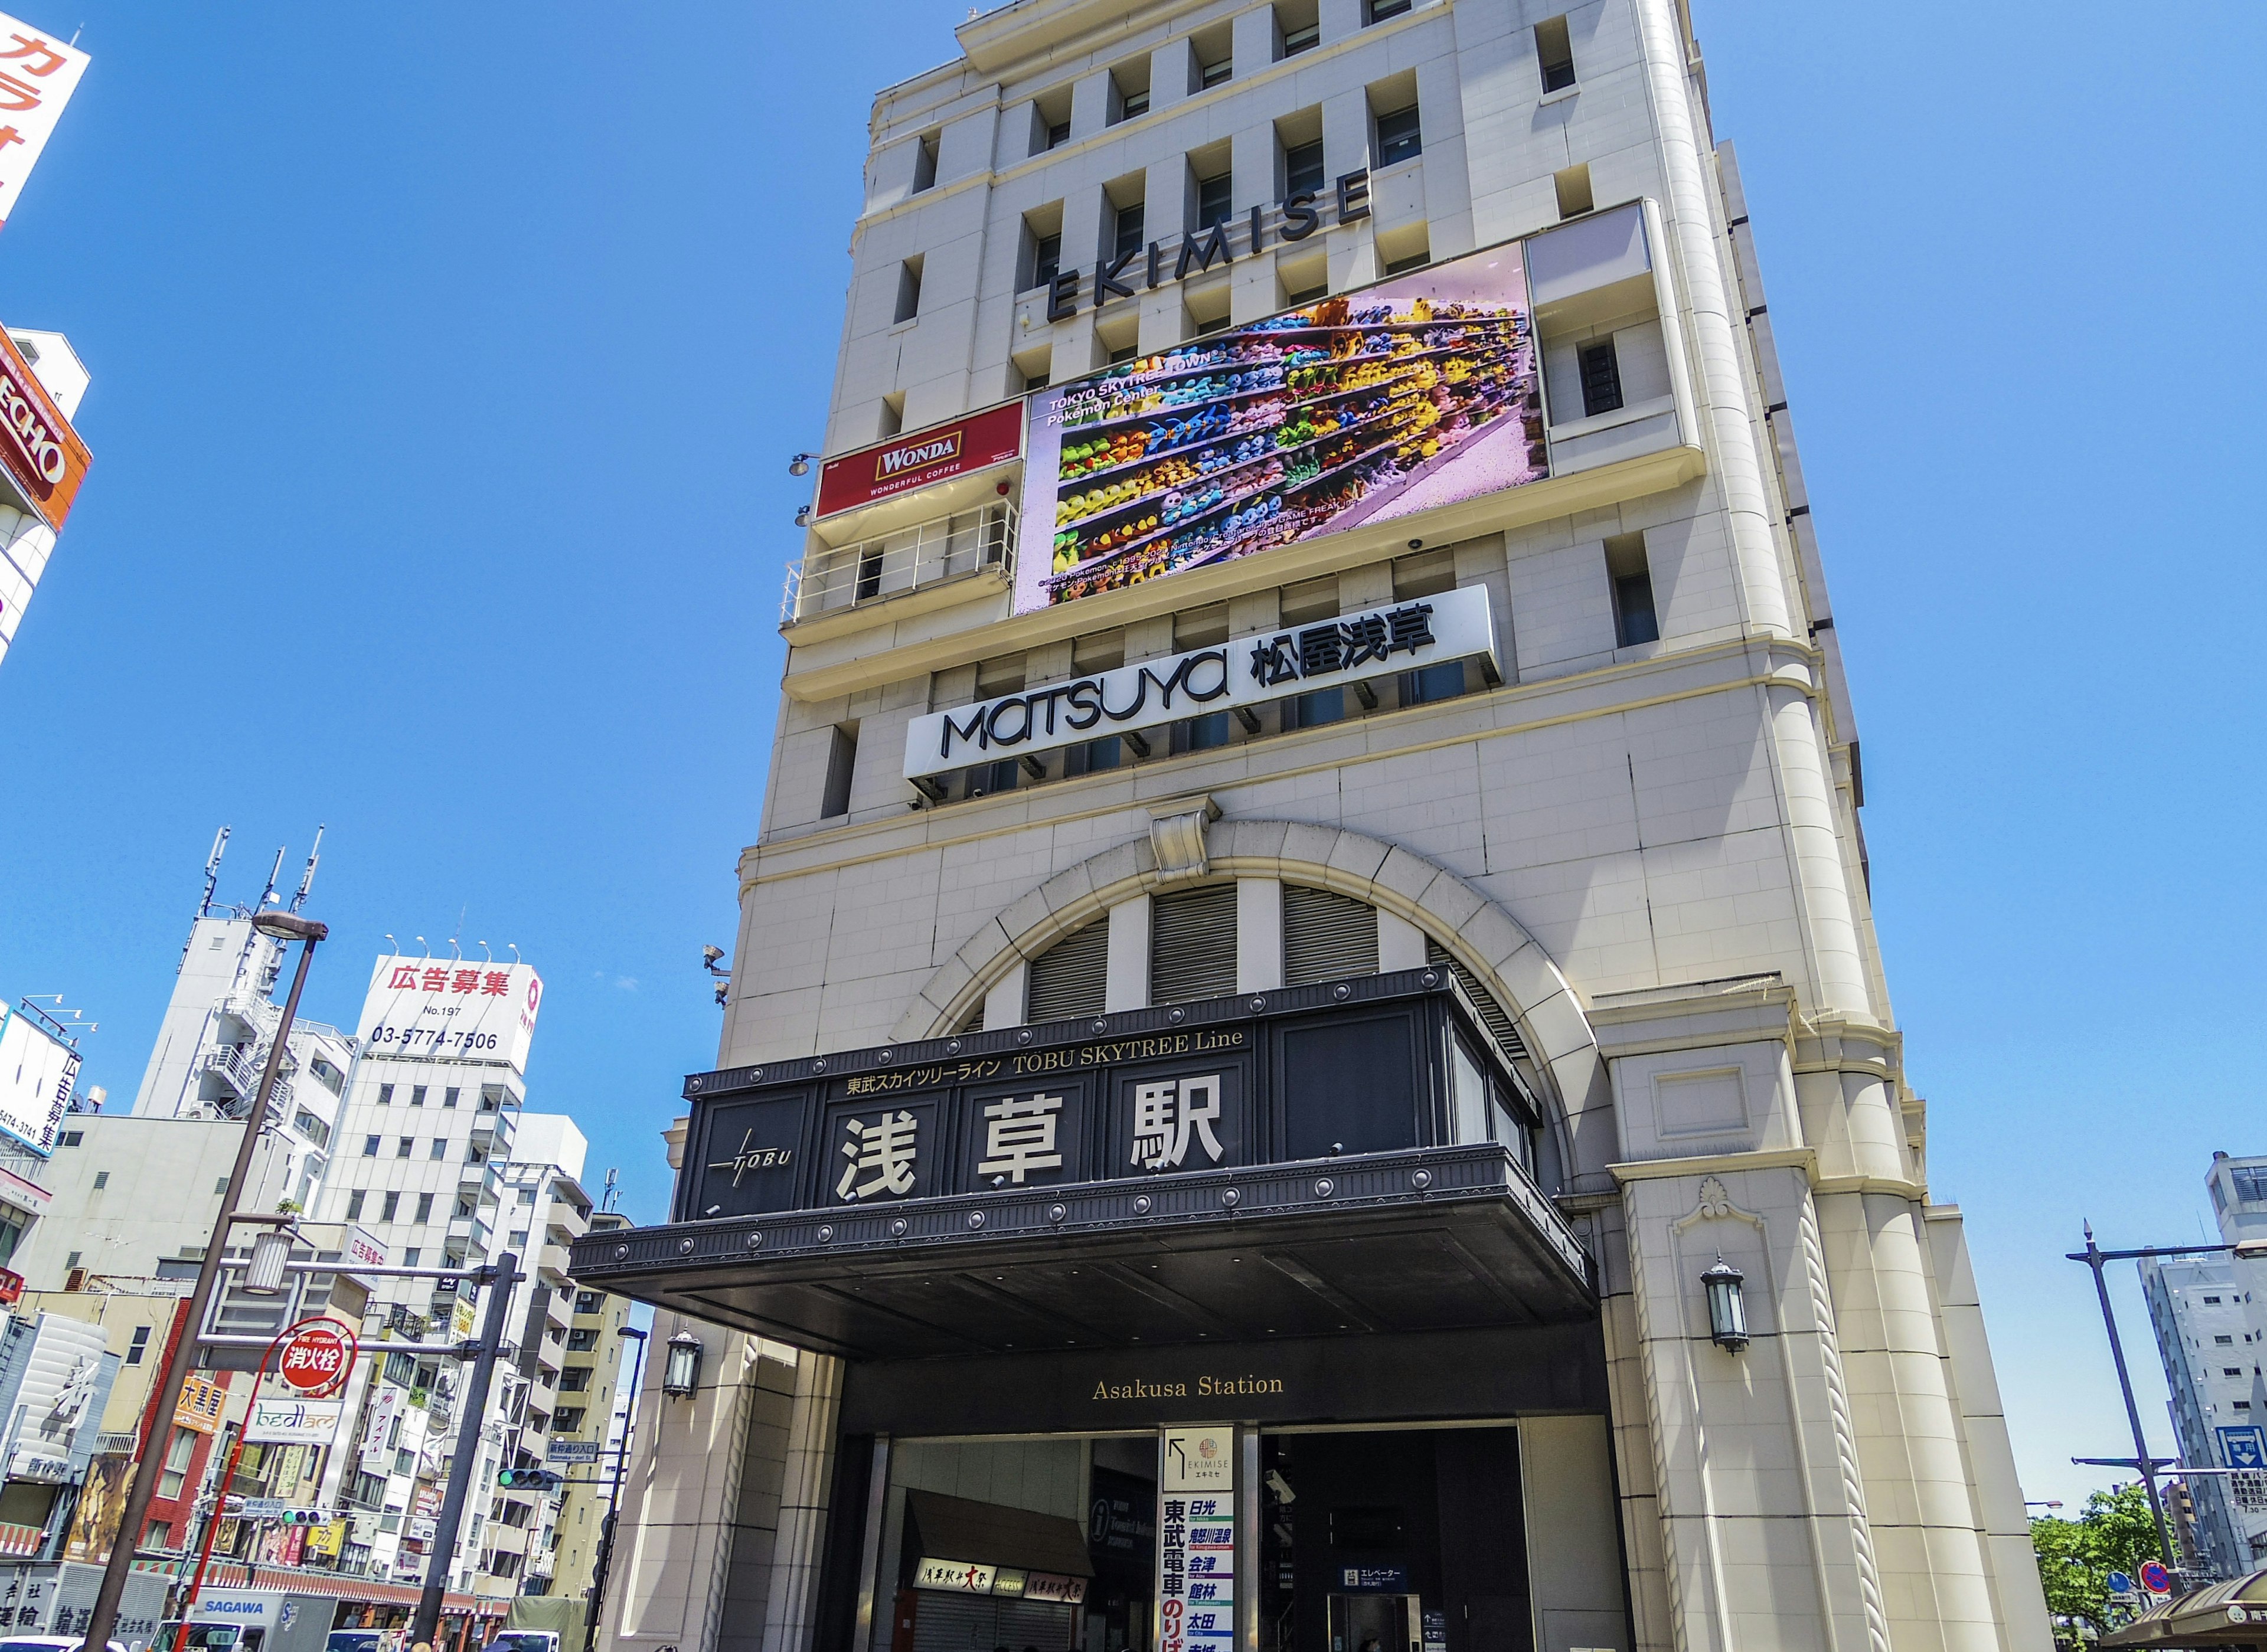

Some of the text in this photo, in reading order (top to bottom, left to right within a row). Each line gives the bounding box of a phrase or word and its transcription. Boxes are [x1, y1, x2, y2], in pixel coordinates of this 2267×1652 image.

[1047, 167, 1371, 323] EKIMISE
[1048, 388, 1096, 411] TOKYO
[1099, 368, 1164, 395] SKYTREE
[1047, 384, 1161, 427] Pokémon Center
[882, 439, 955, 474] WONDA
[870, 463, 961, 496] WONDERFUL COFFEE
[1250, 603, 1436, 688] 松屋浅草
[388, 966, 511, 997] 広告募集
[371, 1026, 498, 1050] 03-5774-7506
[1013, 1031, 1243, 1075] TOBU SKYTREE Line
[847, 1060, 1002, 1096] 東武スカイツリーライン
[37, 1052, 82, 1152] 広告募集
[836, 1074, 1224, 1200] 浅草駅
[733, 1150, 792, 1170] TOBU
[312, 1336, 339, 1345] HYDRANT
[285, 1346, 340, 1372] 消火栓
[179, 1380, 222, 1417] 大黒屋
[1092, 1374, 1283, 1400] Asakusa Station
[550, 1444, 594, 1454] 新仲通り入口
[1188, 1460, 1229, 1469] EKIMISE
[1190, 1500, 1216, 1516] 日光
[1188, 1528, 1232, 1544] 鬼怒川温泉
[1188, 1556, 1216, 1572] 会津
[1188, 1584, 1217, 1599] 館林
[205, 1601, 263, 1614] SAGAWA
[1187, 1613, 1216, 1630] 太田
